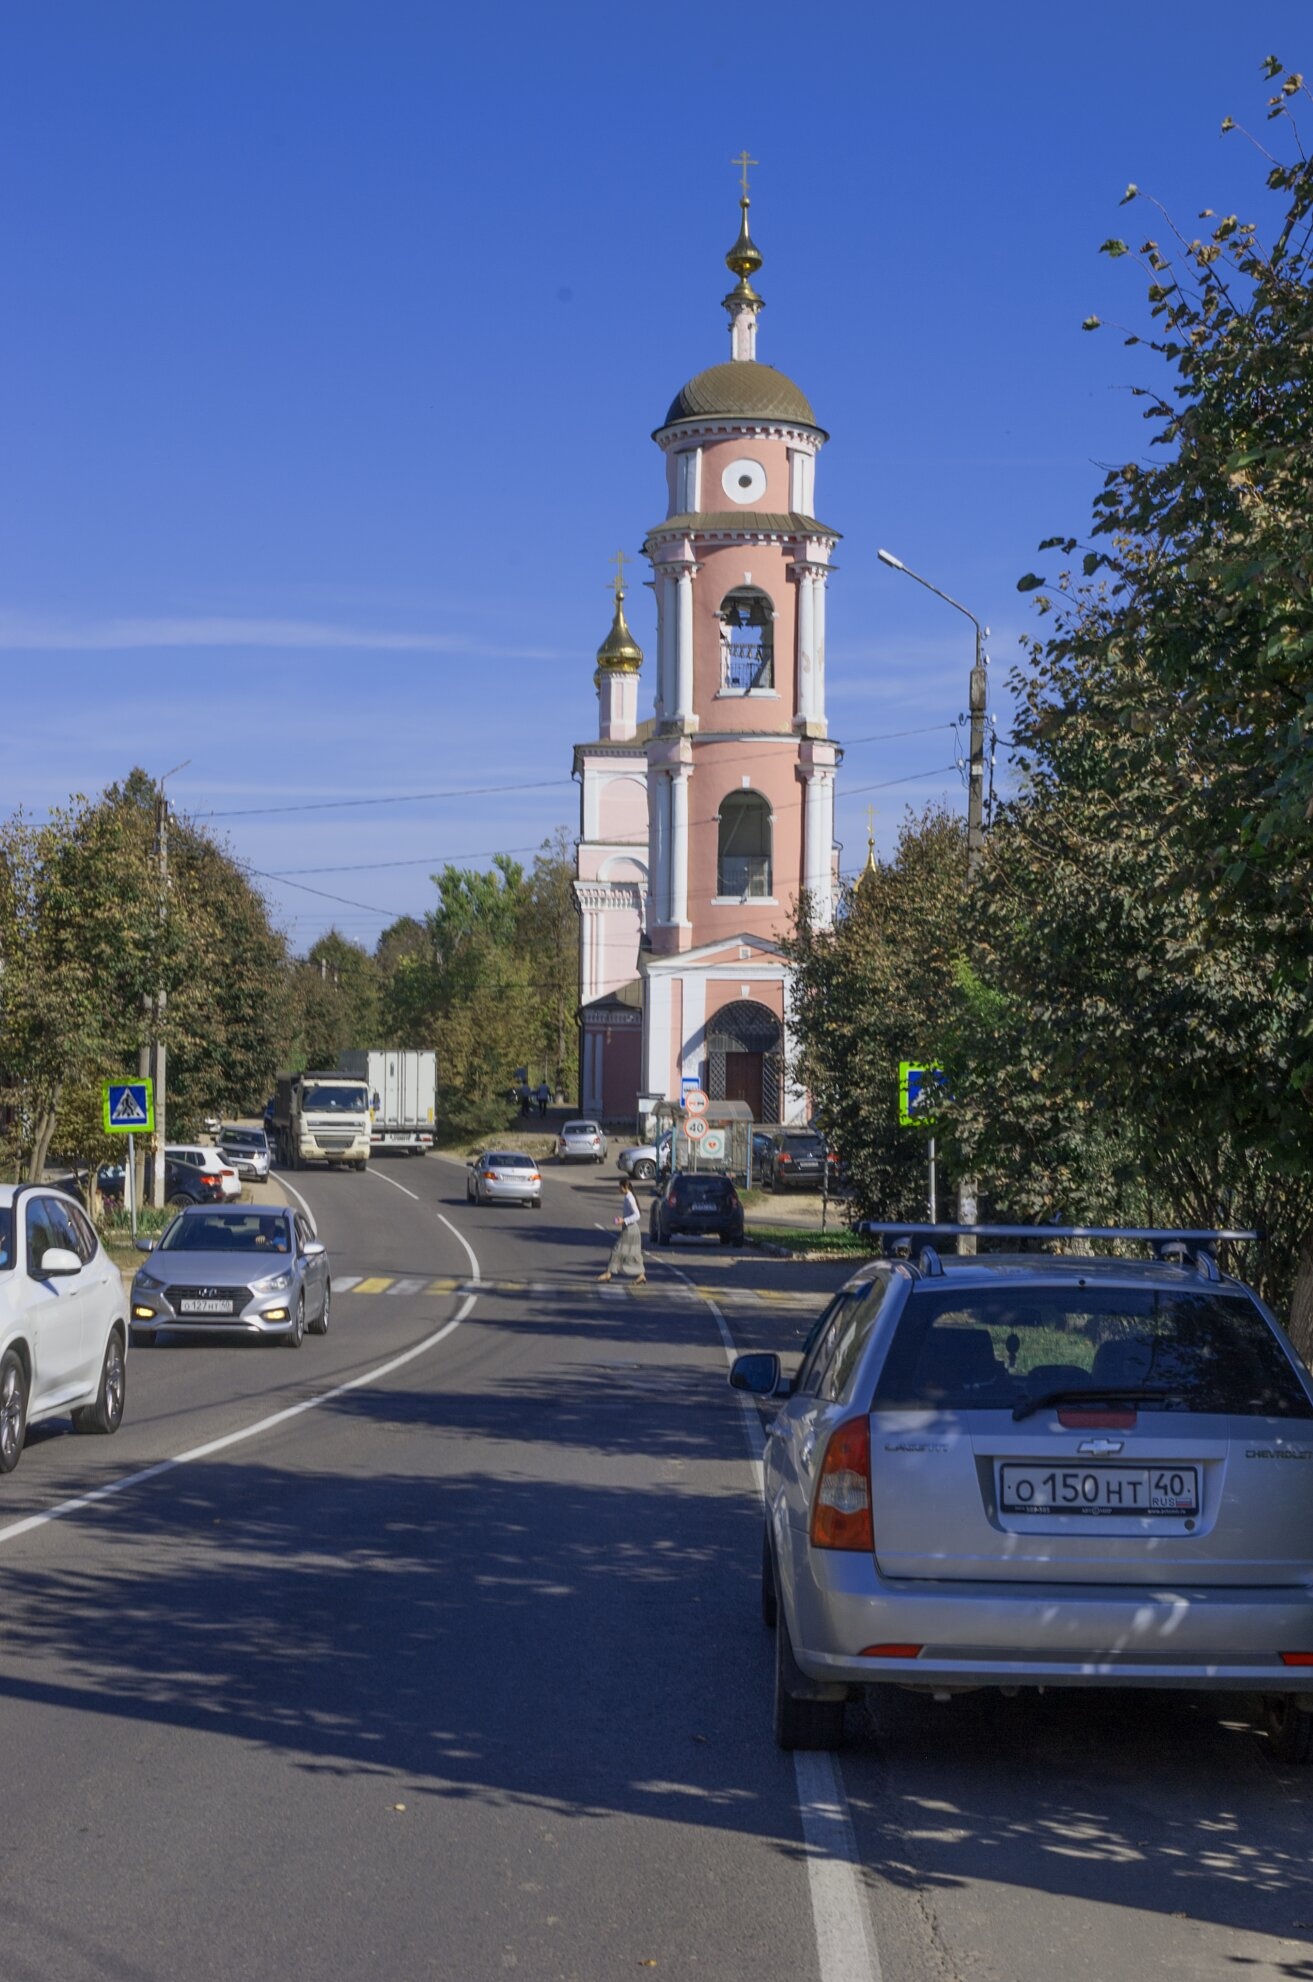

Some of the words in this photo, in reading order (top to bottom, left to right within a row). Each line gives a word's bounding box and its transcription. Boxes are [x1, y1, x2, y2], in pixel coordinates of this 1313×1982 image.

[690, 1123, 704, 1133] 40
[1245, 1449, 1313, 1460] CHEVROLET
[1154, 1473, 1185, 1496] 40
[1152, 1497, 1176, 1508] RUS
